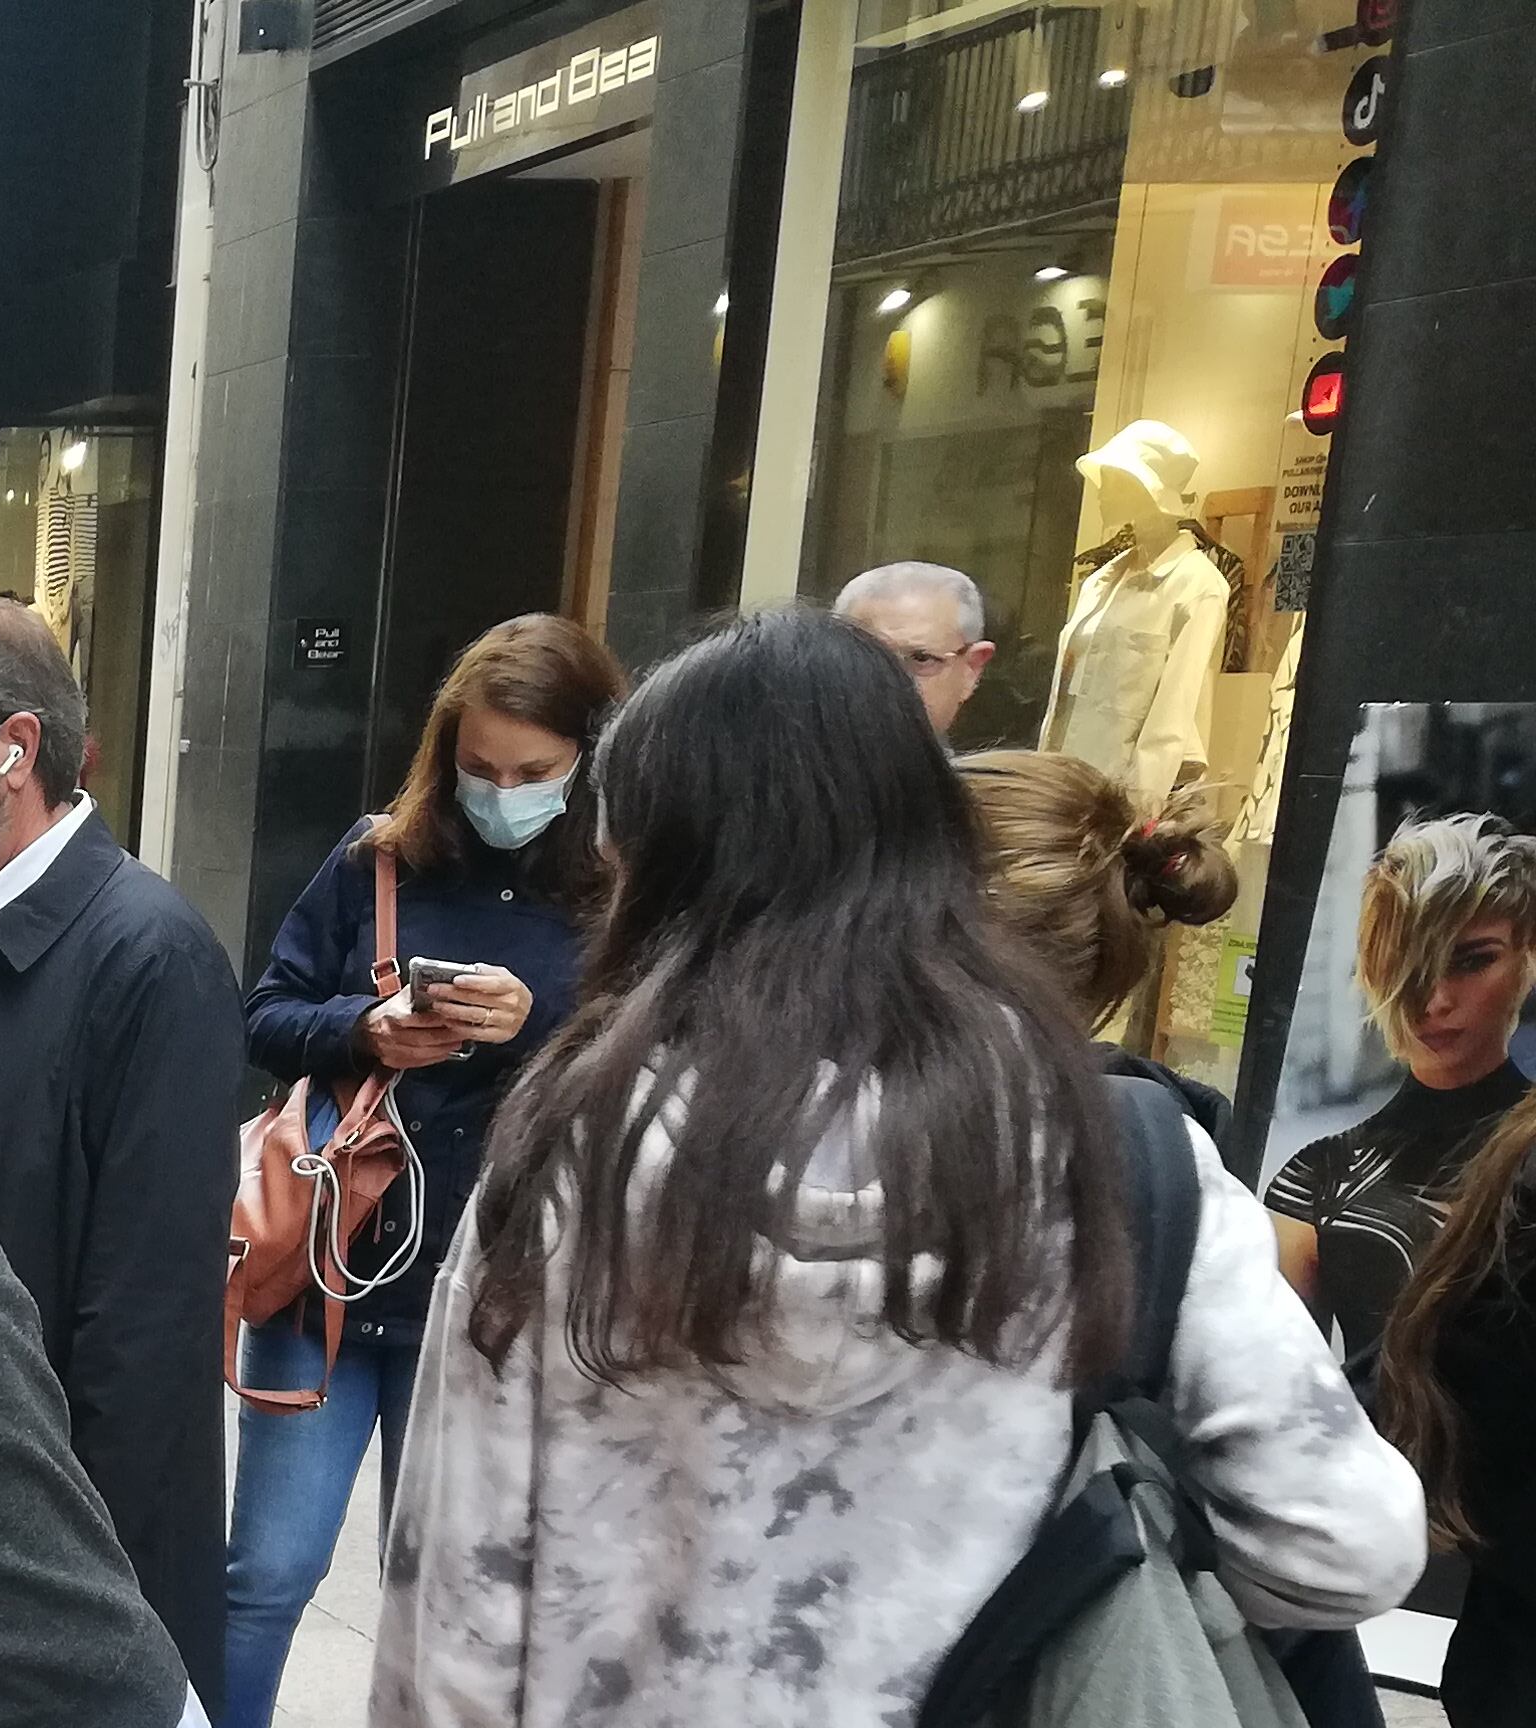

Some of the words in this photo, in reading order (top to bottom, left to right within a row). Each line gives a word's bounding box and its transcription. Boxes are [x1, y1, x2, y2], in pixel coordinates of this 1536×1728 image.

[424, 92, 487, 160] Pull
[492, 68, 561, 134] and
[569, 35, 662, 105] Bea
[315, 628, 340, 638] Pull
